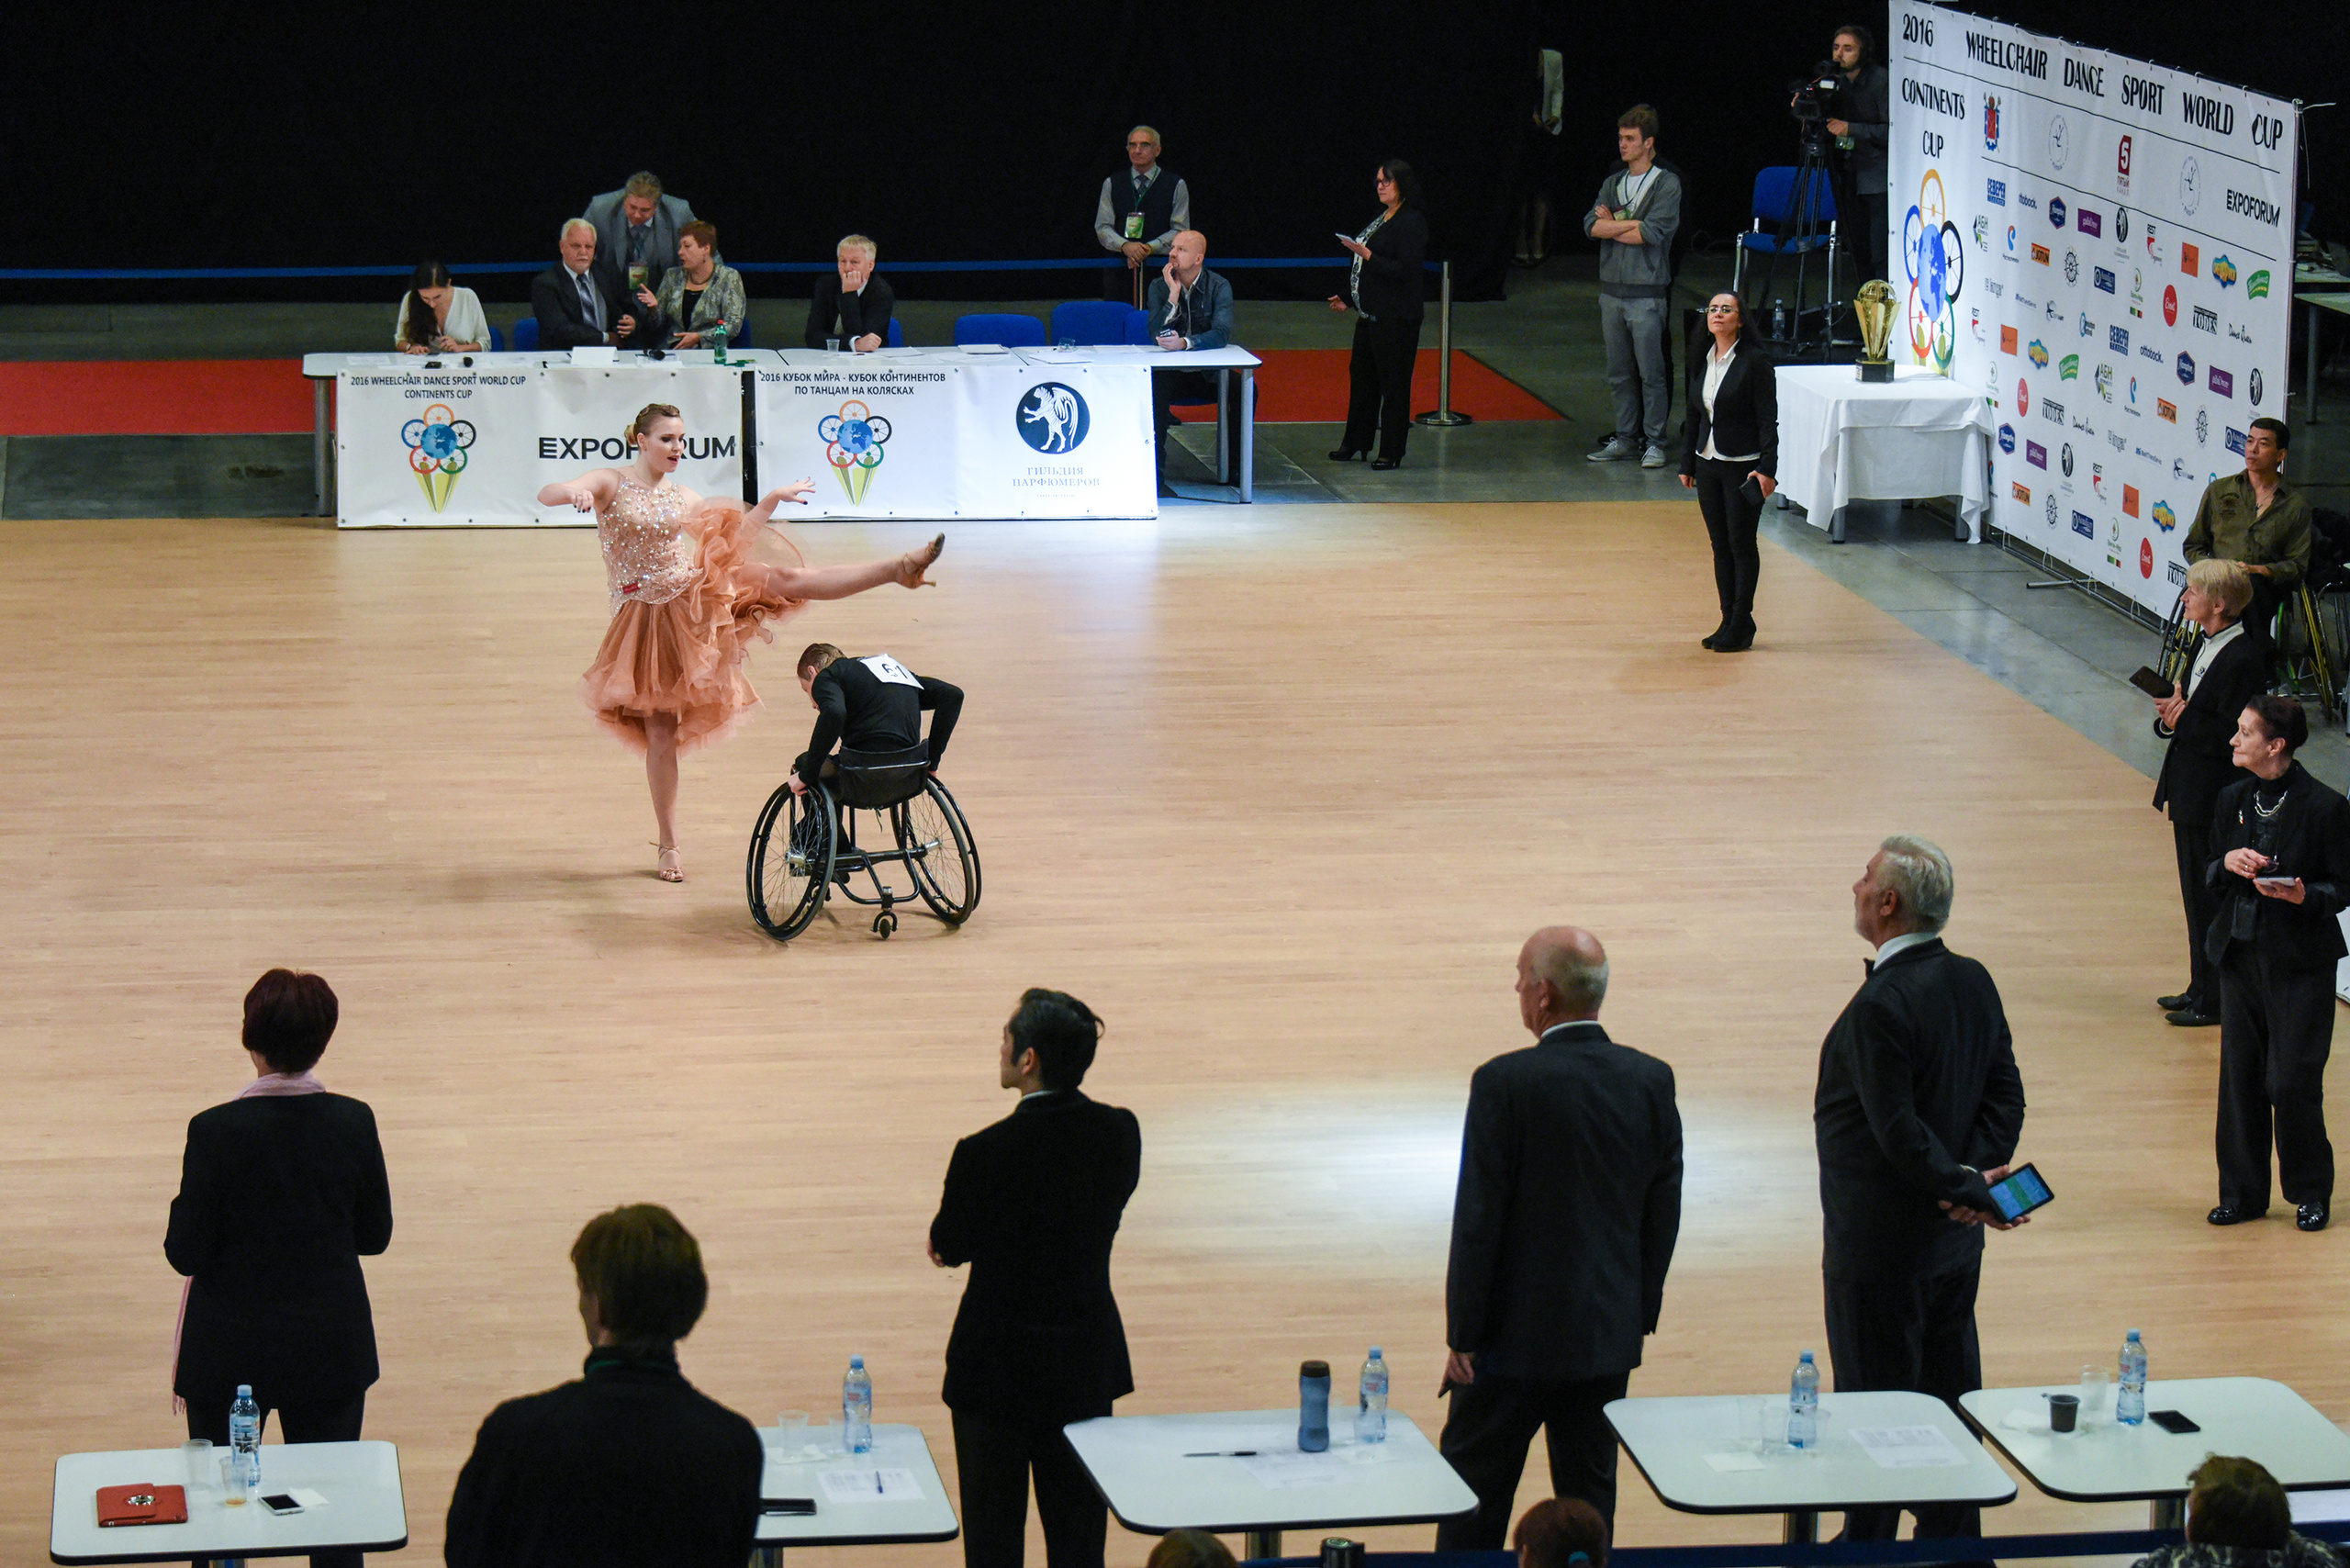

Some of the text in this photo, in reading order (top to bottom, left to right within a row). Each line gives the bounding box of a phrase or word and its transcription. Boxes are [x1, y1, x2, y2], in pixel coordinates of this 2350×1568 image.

[1903, 14, 2282, 150] 2016 WHEELCHAIR DANCE SPORT WORLD CUP
[1902, 78, 1964, 120] CONTINENTS
[1922, 130, 1943, 158] CUP
[2121, 141, 2130, 169] 5
[2226, 189, 2280, 228] EXPOFORUM
[2194, 312, 2217, 335] TODES
[351, 375, 526, 386] 2016 WHEELCHAIR DANCE SPORT WORLD CUP
[761, 374, 780, 382] 2016
[783, 373, 812, 382] КУБОК
[814, 373, 840, 382] МИРА
[848, 373, 878, 382] КУБОК
[880, 373, 946, 382] КОНТИНЕНТОВ
[405, 389, 473, 399] CONTINENTS CUP
[794, 386, 914, 397] ПО ТАНЦАМ НА КОЛЯСКАХ
[2042, 404, 2065, 426] TODES
[2162, 404, 2177, 421] JOTUN
[1027, 466, 1083, 476] ГИЛЬДИЯ
[1013, 478, 1100, 487] ПАРФЮМЕРОВ
